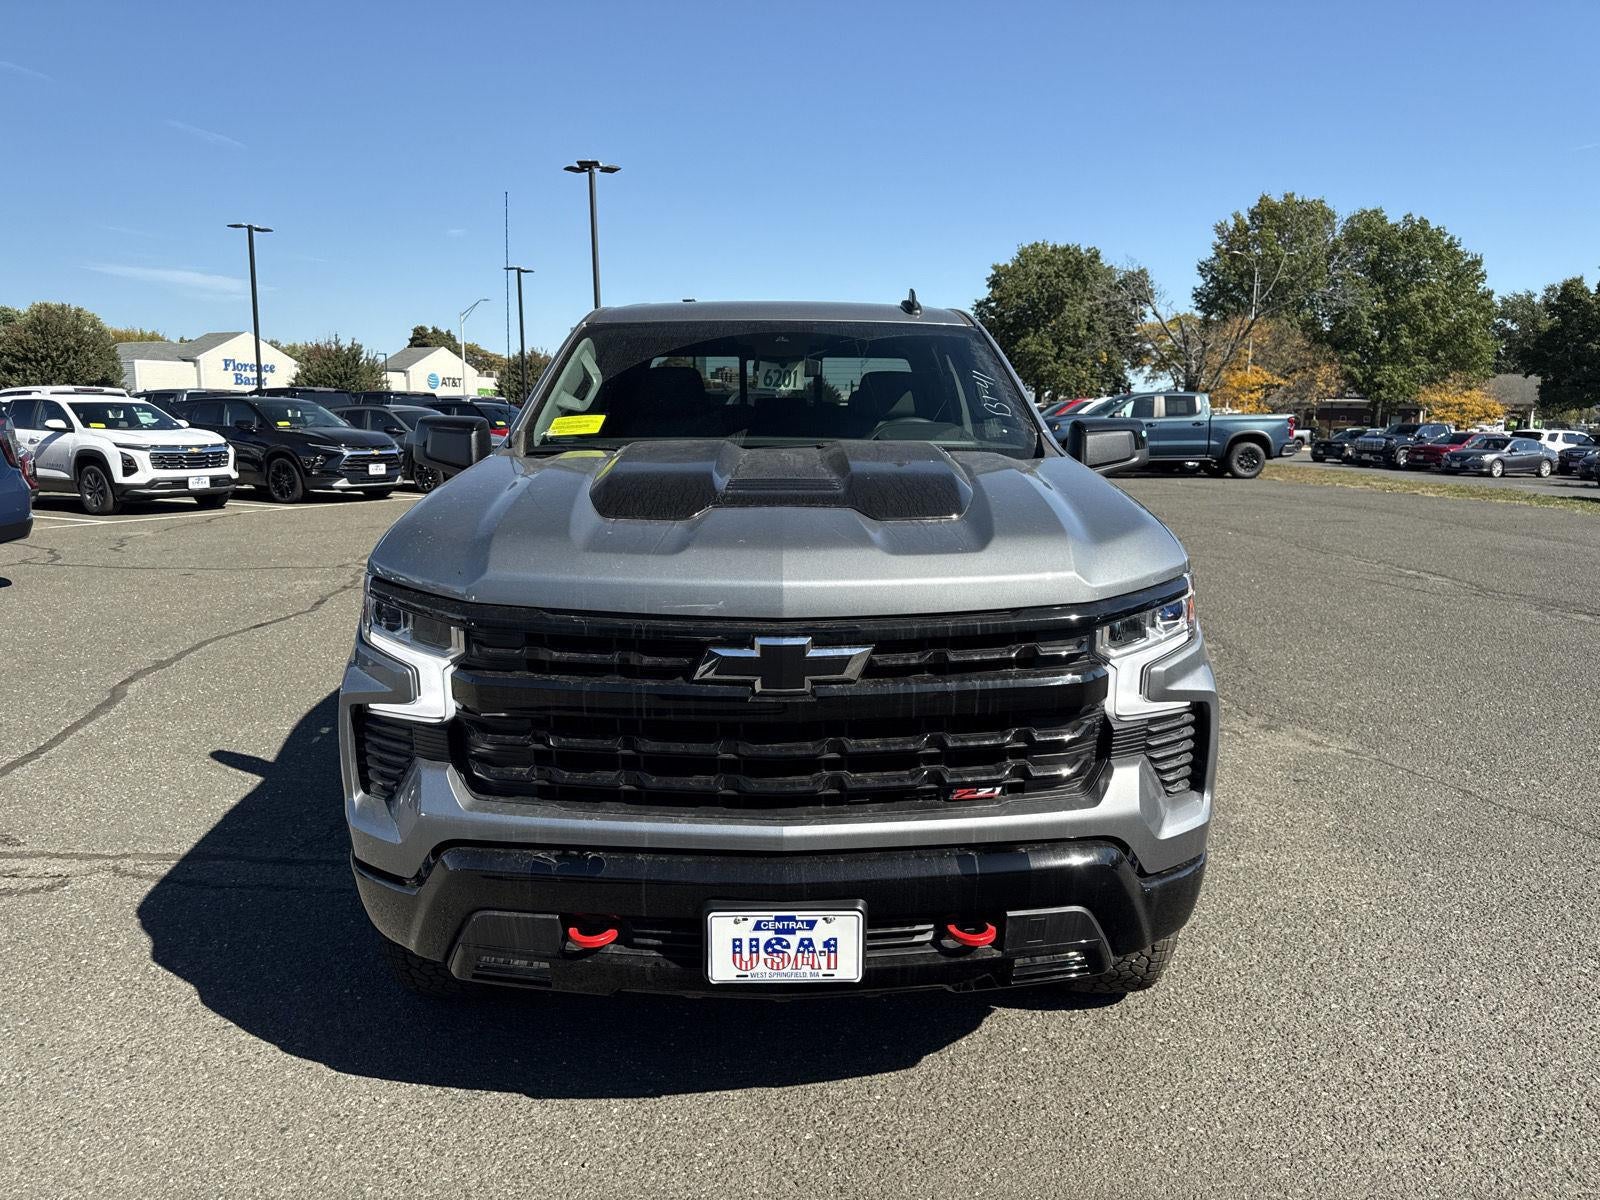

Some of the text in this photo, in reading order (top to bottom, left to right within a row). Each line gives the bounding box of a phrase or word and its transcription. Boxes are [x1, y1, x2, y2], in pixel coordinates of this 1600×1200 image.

[222, 359, 276, 373] Florece
[440, 376, 462, 388] AT&T
[763, 368, 798, 388] 6201
[951, 786, 1002, 800] Z71
[760, 920, 810, 931] CENTRAL
[750, 971, 767, 979] WEST
[809, 971, 820, 979] MA
